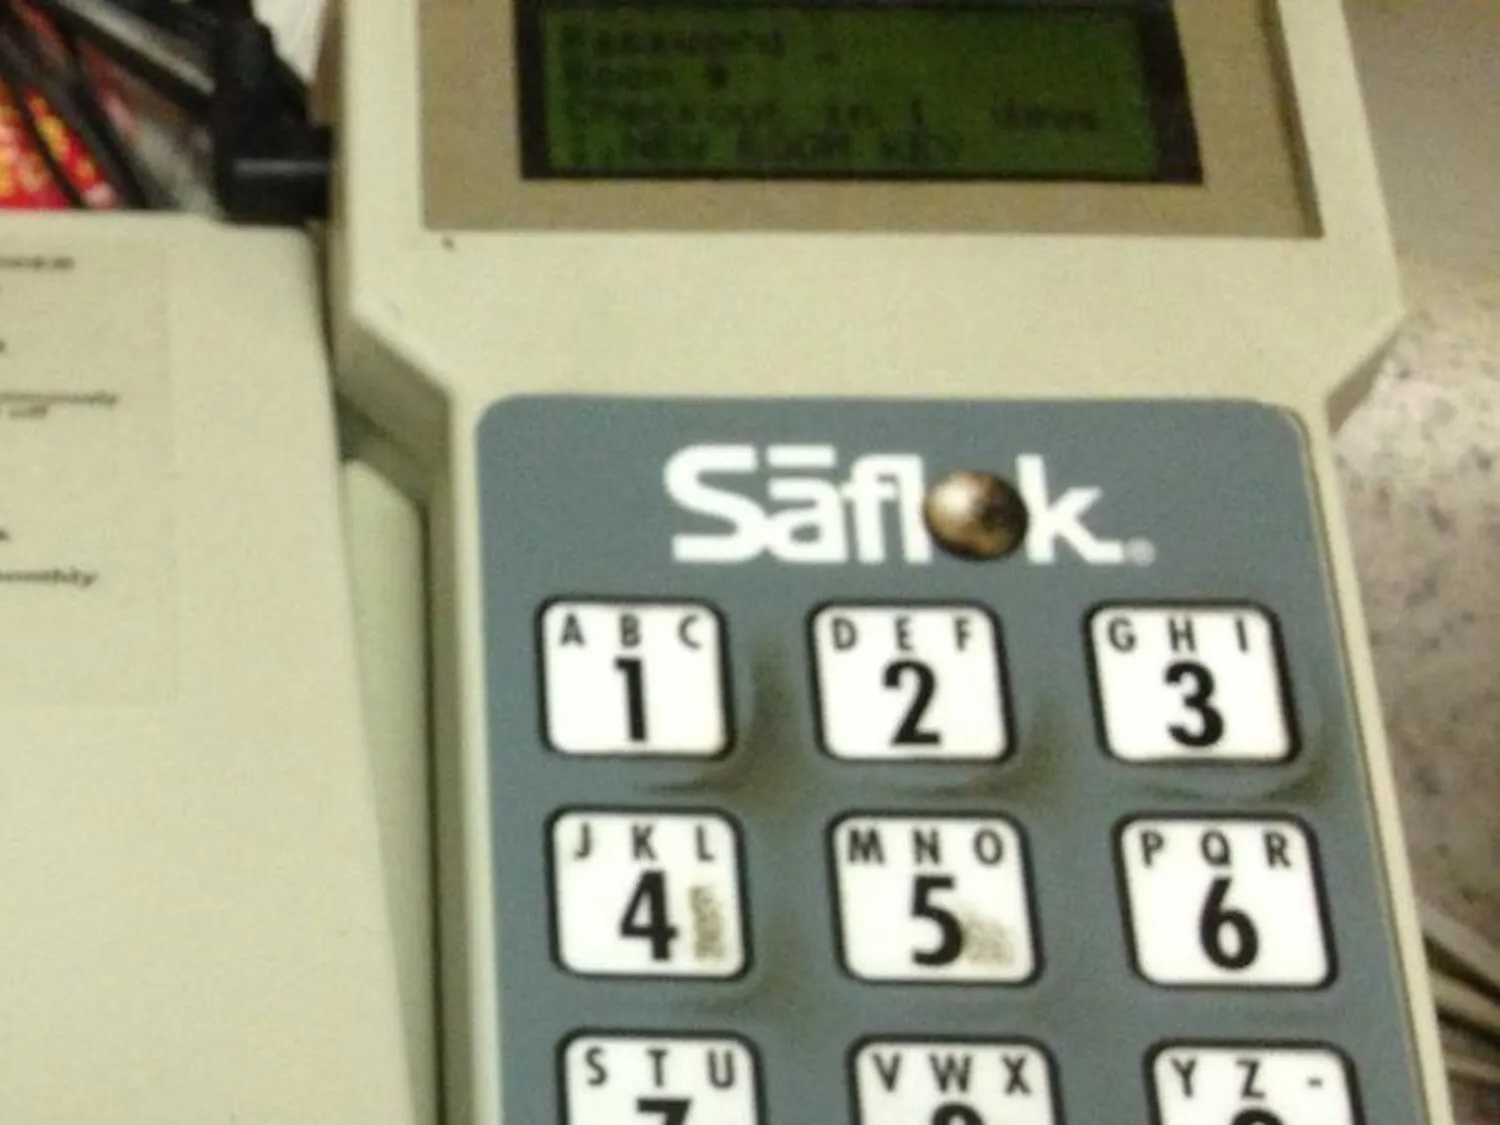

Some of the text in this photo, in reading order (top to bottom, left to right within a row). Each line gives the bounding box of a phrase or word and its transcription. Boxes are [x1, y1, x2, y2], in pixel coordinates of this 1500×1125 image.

[614, 656, 1226, 749] 1 2 3
[618, 870, 1260, 972] 4 5 6
